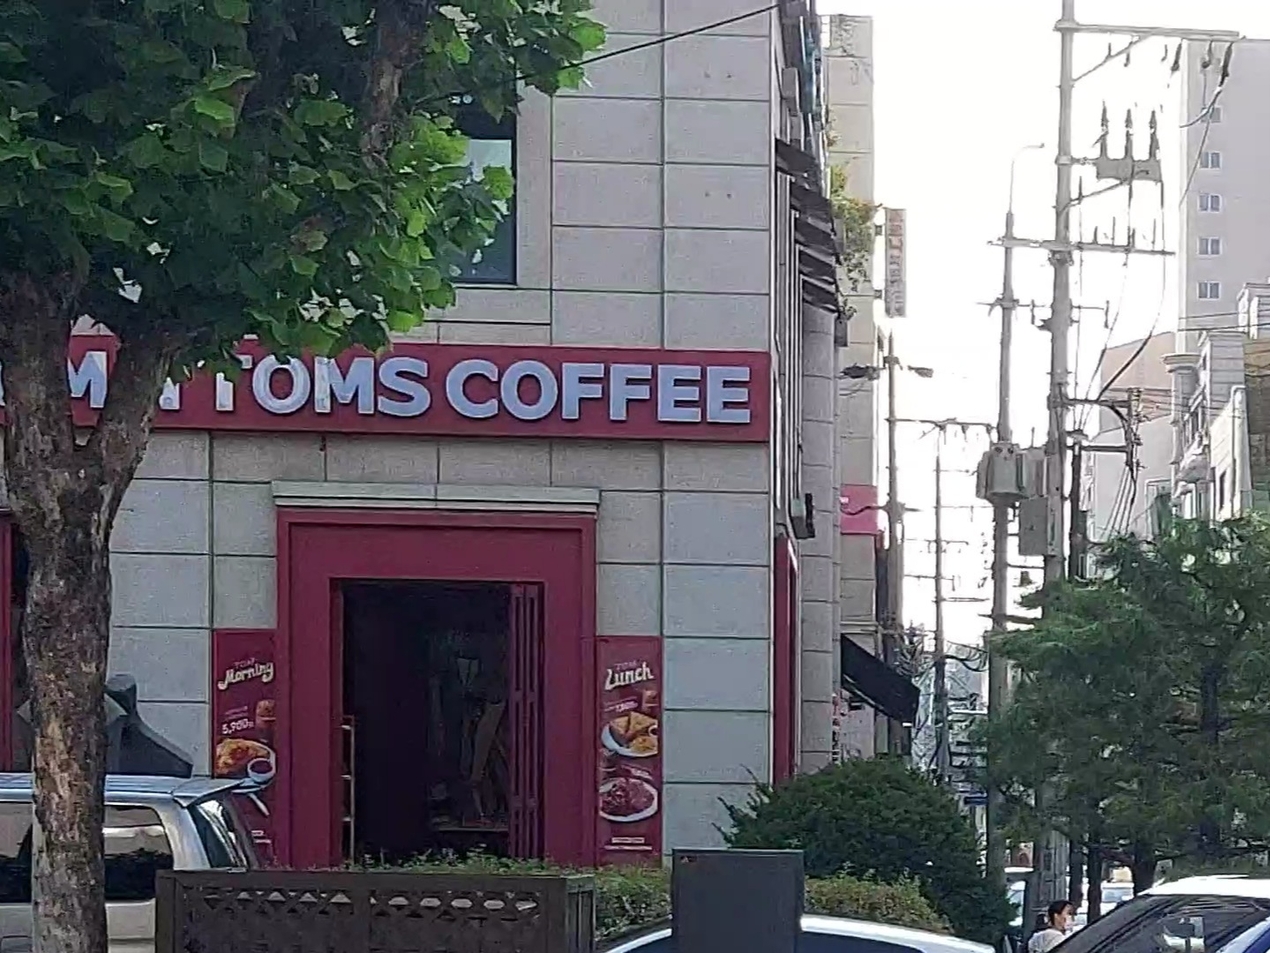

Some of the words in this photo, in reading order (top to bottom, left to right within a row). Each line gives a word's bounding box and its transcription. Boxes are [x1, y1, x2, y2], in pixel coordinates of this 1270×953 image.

[446, 359, 750, 423] COFFEE
[217, 662, 274, 690] Morning
[605, 661, 654, 690] Lunch
